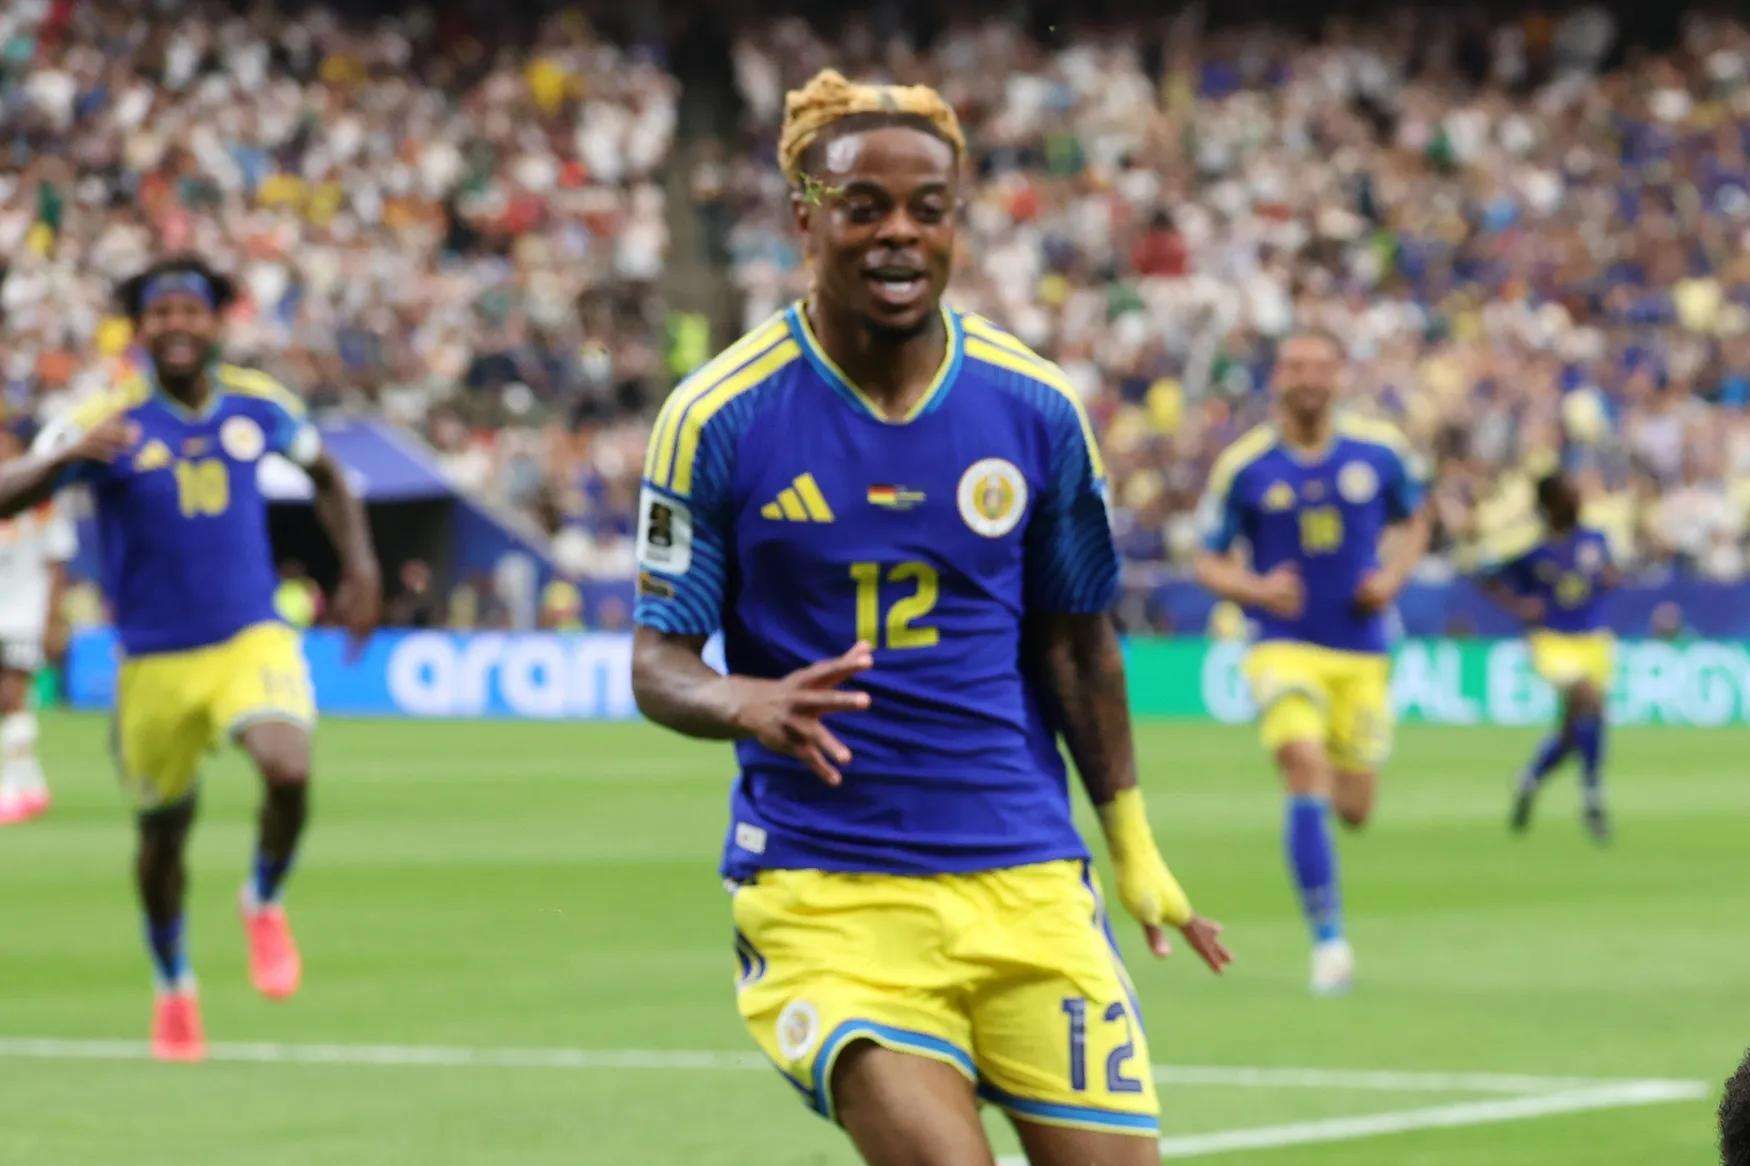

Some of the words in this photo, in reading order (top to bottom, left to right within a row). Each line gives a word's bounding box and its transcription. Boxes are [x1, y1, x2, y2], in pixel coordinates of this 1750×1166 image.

[849, 561, 939, 650] 12
[386, 631, 635, 716] aram
[1061, 997, 1143, 1093] 12
